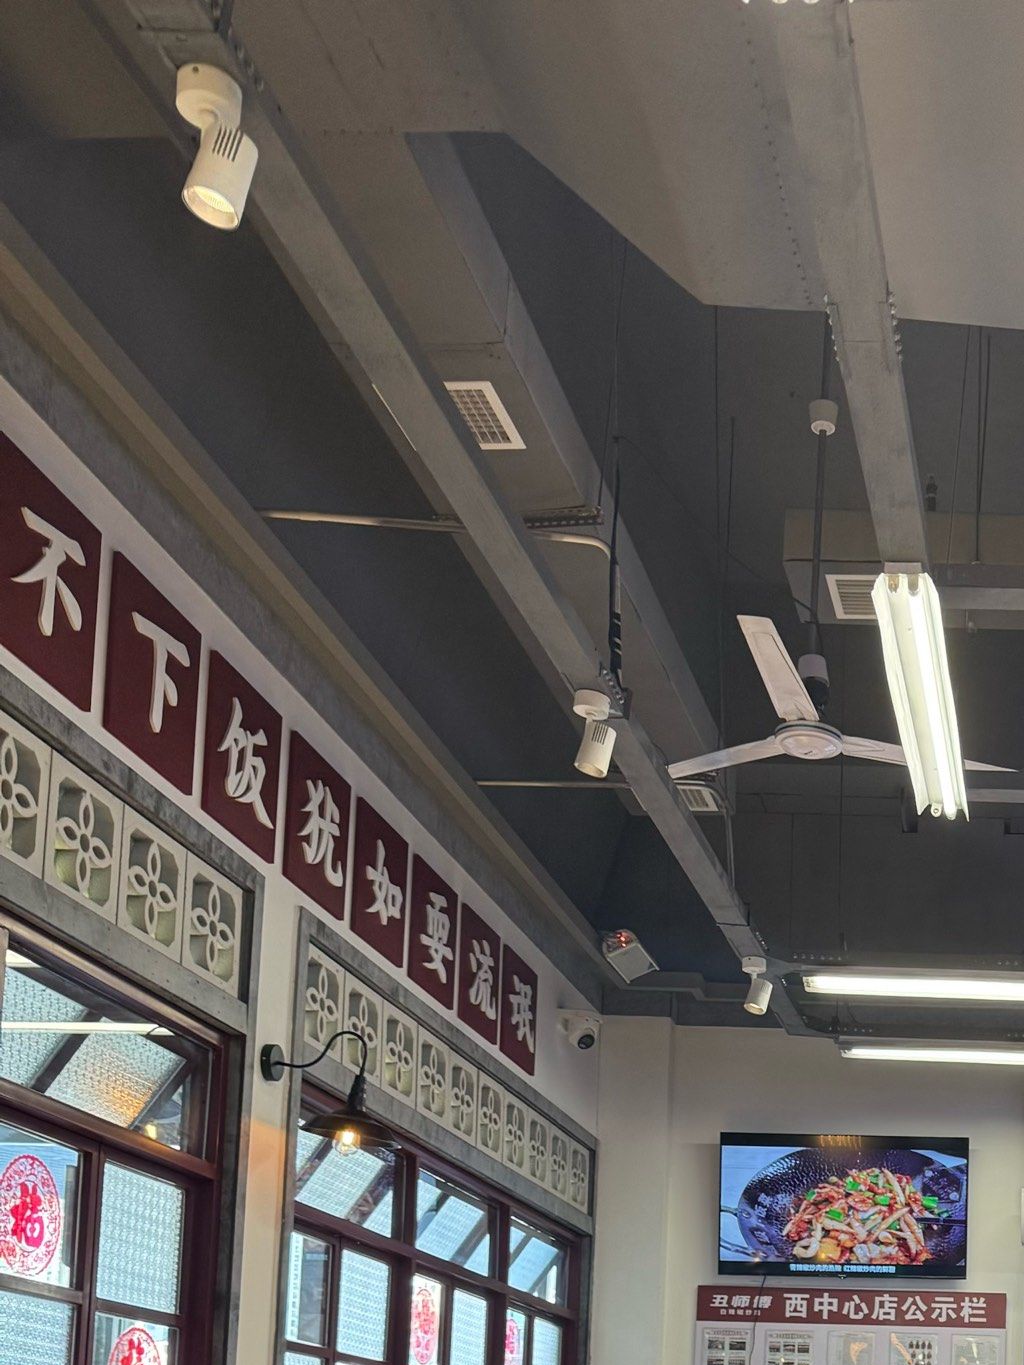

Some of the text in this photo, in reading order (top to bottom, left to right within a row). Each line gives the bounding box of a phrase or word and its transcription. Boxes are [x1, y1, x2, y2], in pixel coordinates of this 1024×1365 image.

[710, 1294, 773, 1309] 丑师傅
[783, 1292, 987, 1324] 西中心店公示栏
